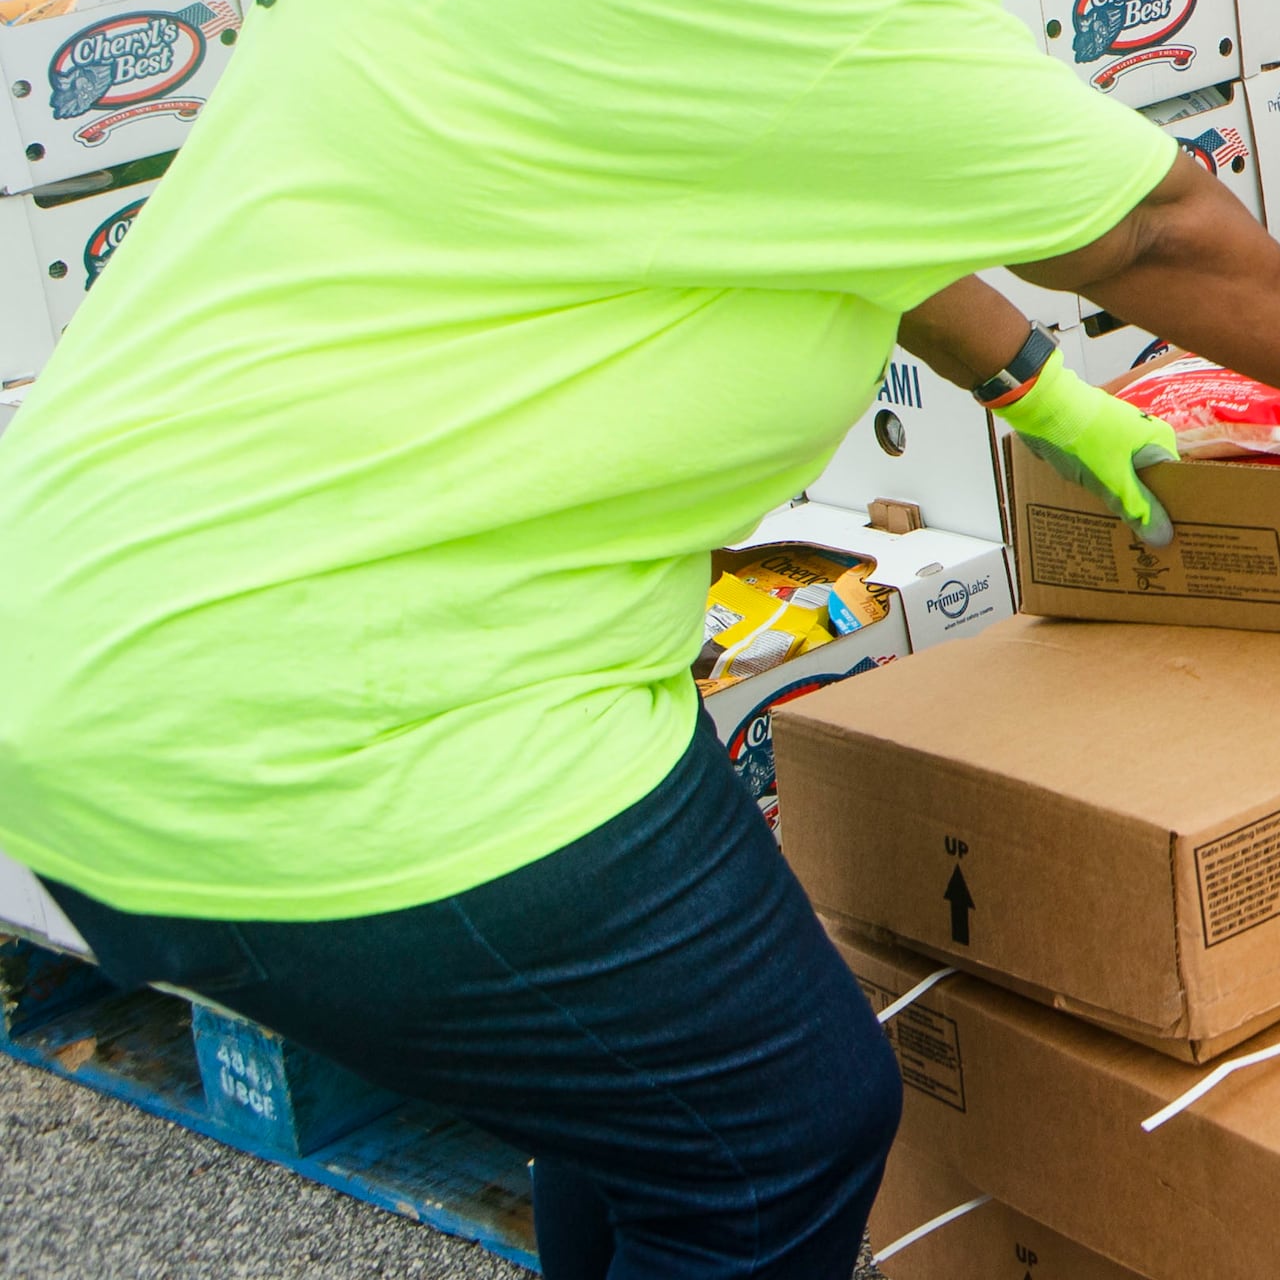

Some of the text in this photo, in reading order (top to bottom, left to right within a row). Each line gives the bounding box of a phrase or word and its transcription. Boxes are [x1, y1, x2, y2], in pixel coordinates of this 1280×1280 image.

[73, 17, 178, 63] Cheryl's
[114, 49, 172, 85] Best
[878, 362, 923, 409] AMI
[944, 835, 969, 859] UP
